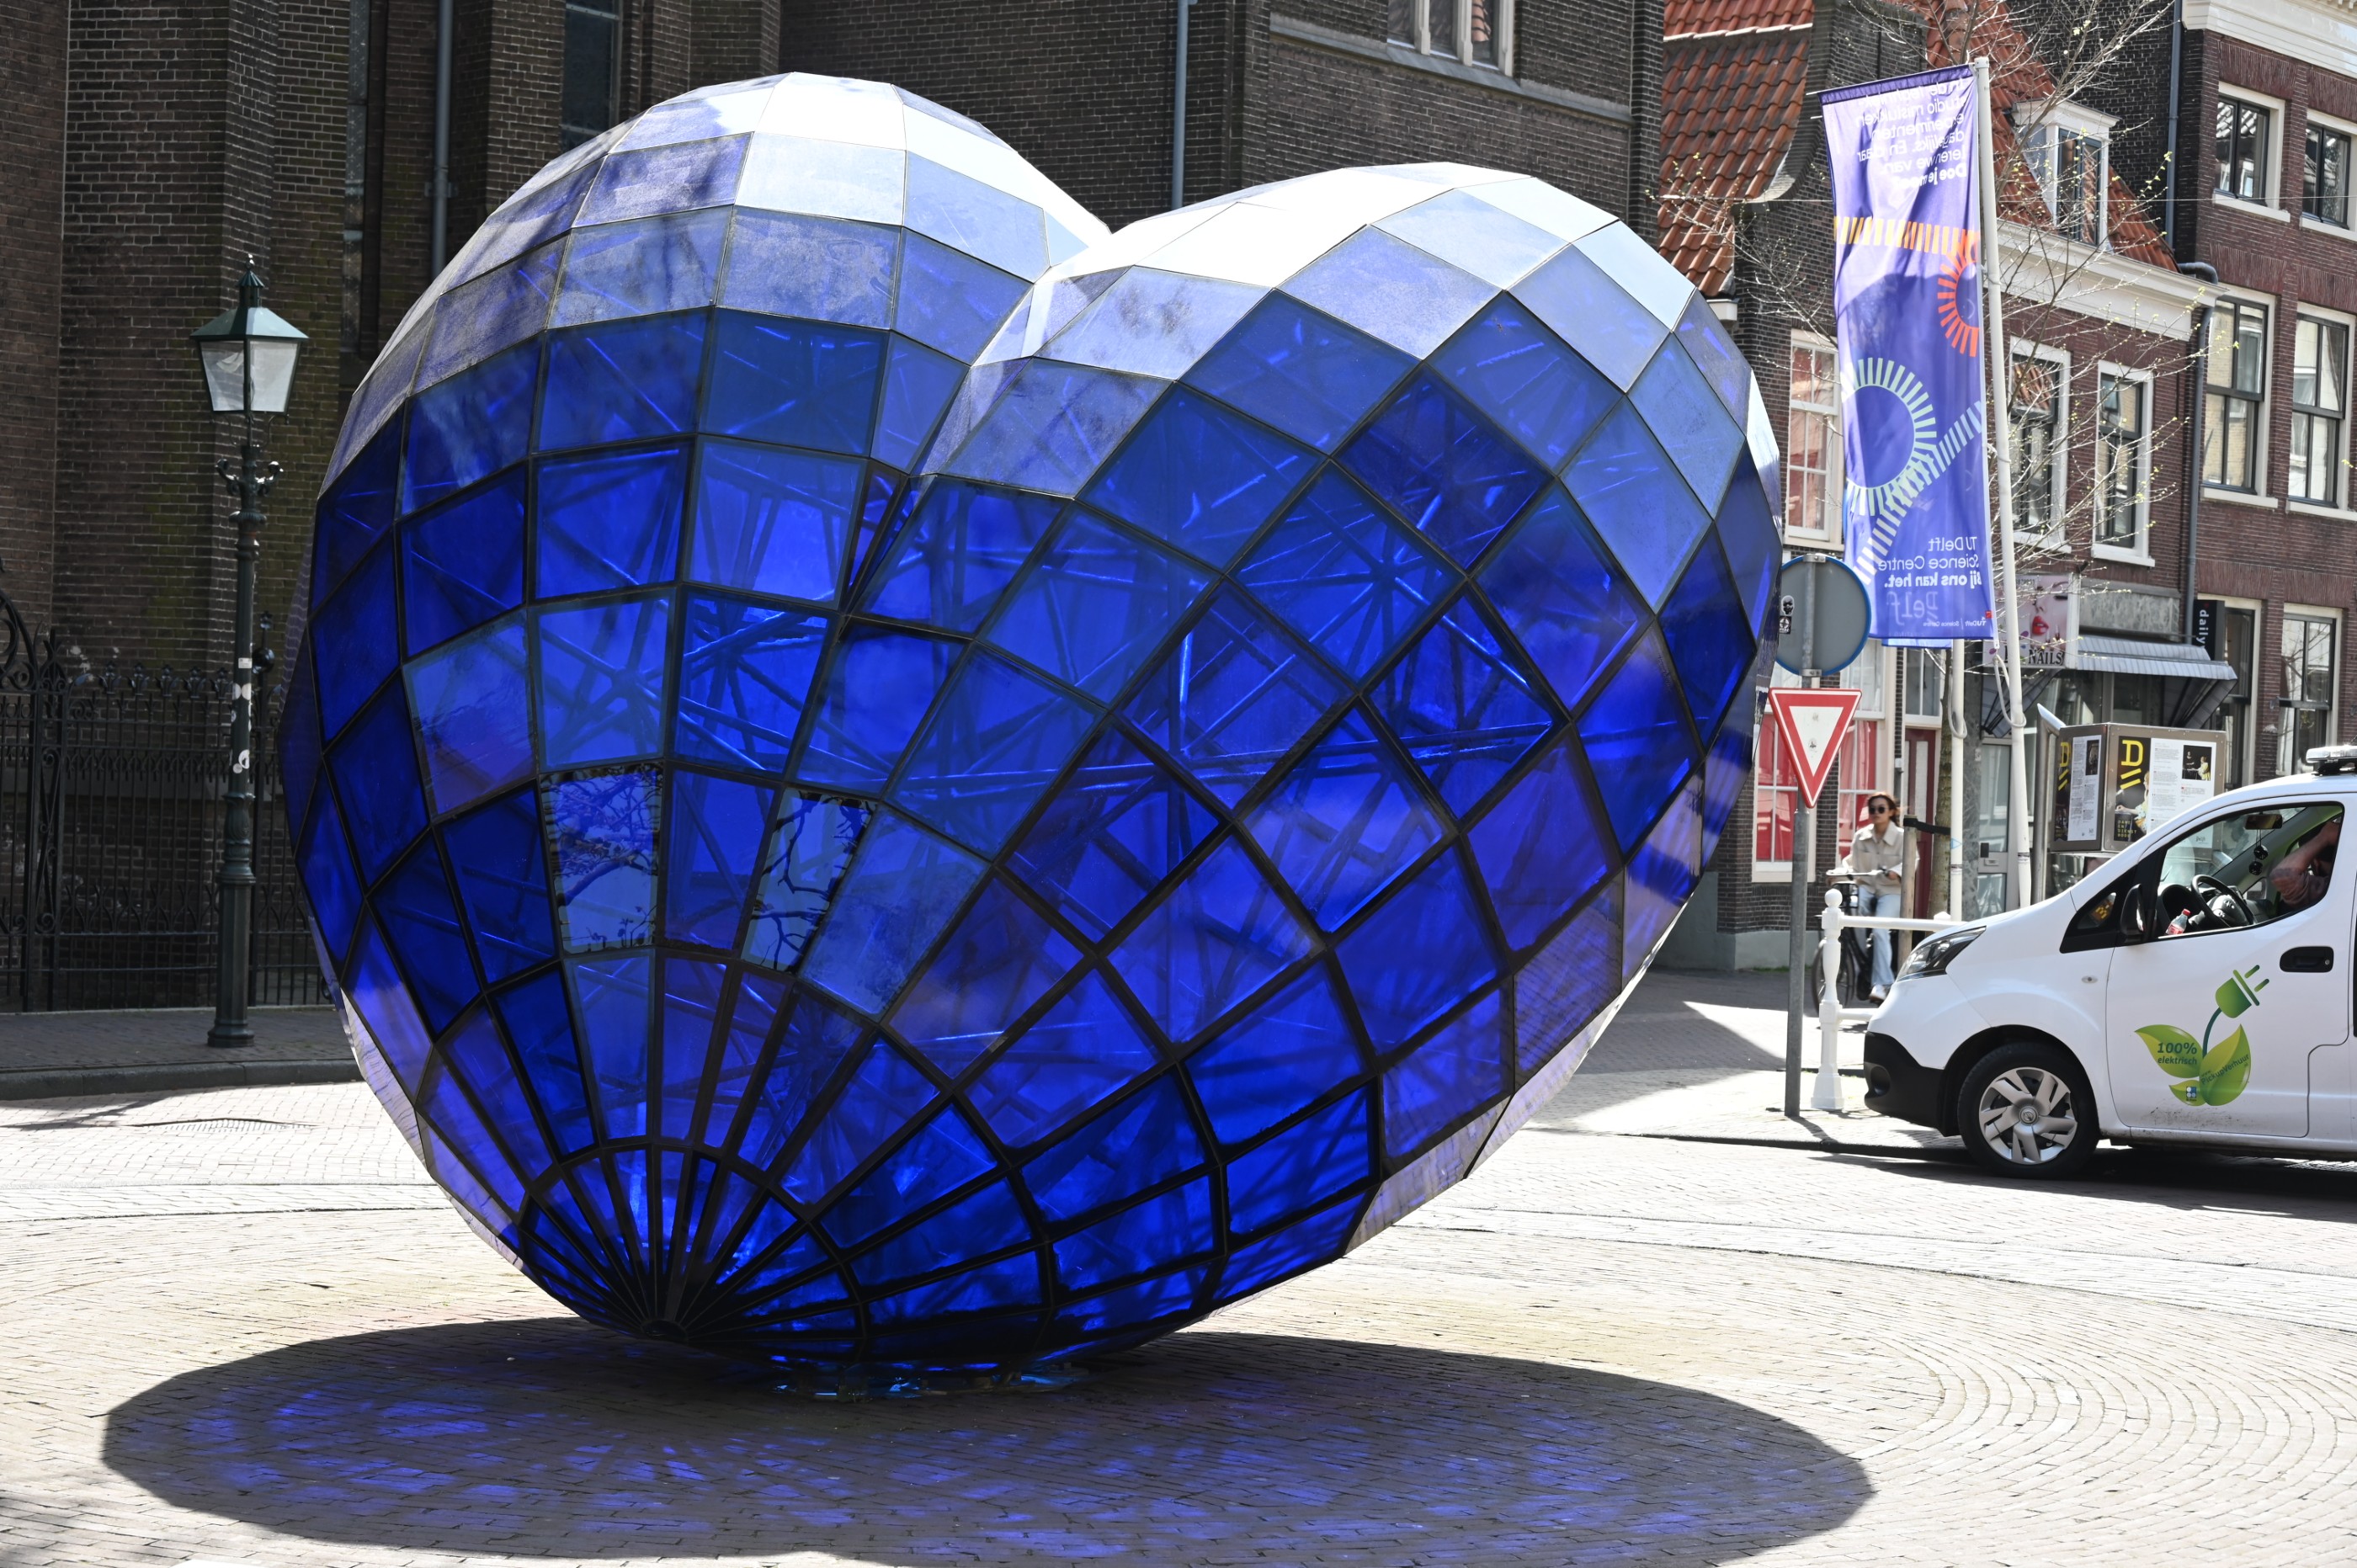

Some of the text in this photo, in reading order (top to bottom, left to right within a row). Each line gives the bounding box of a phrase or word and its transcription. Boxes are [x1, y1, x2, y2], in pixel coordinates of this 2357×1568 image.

[2028, 649, 2062, 665] NAILS
[2157, 1042, 2197, 1055] 100%
[2157, 1055, 2197, 1066] elektrisch
[2200, 1054, 2249, 1085] PickupVerhuur
